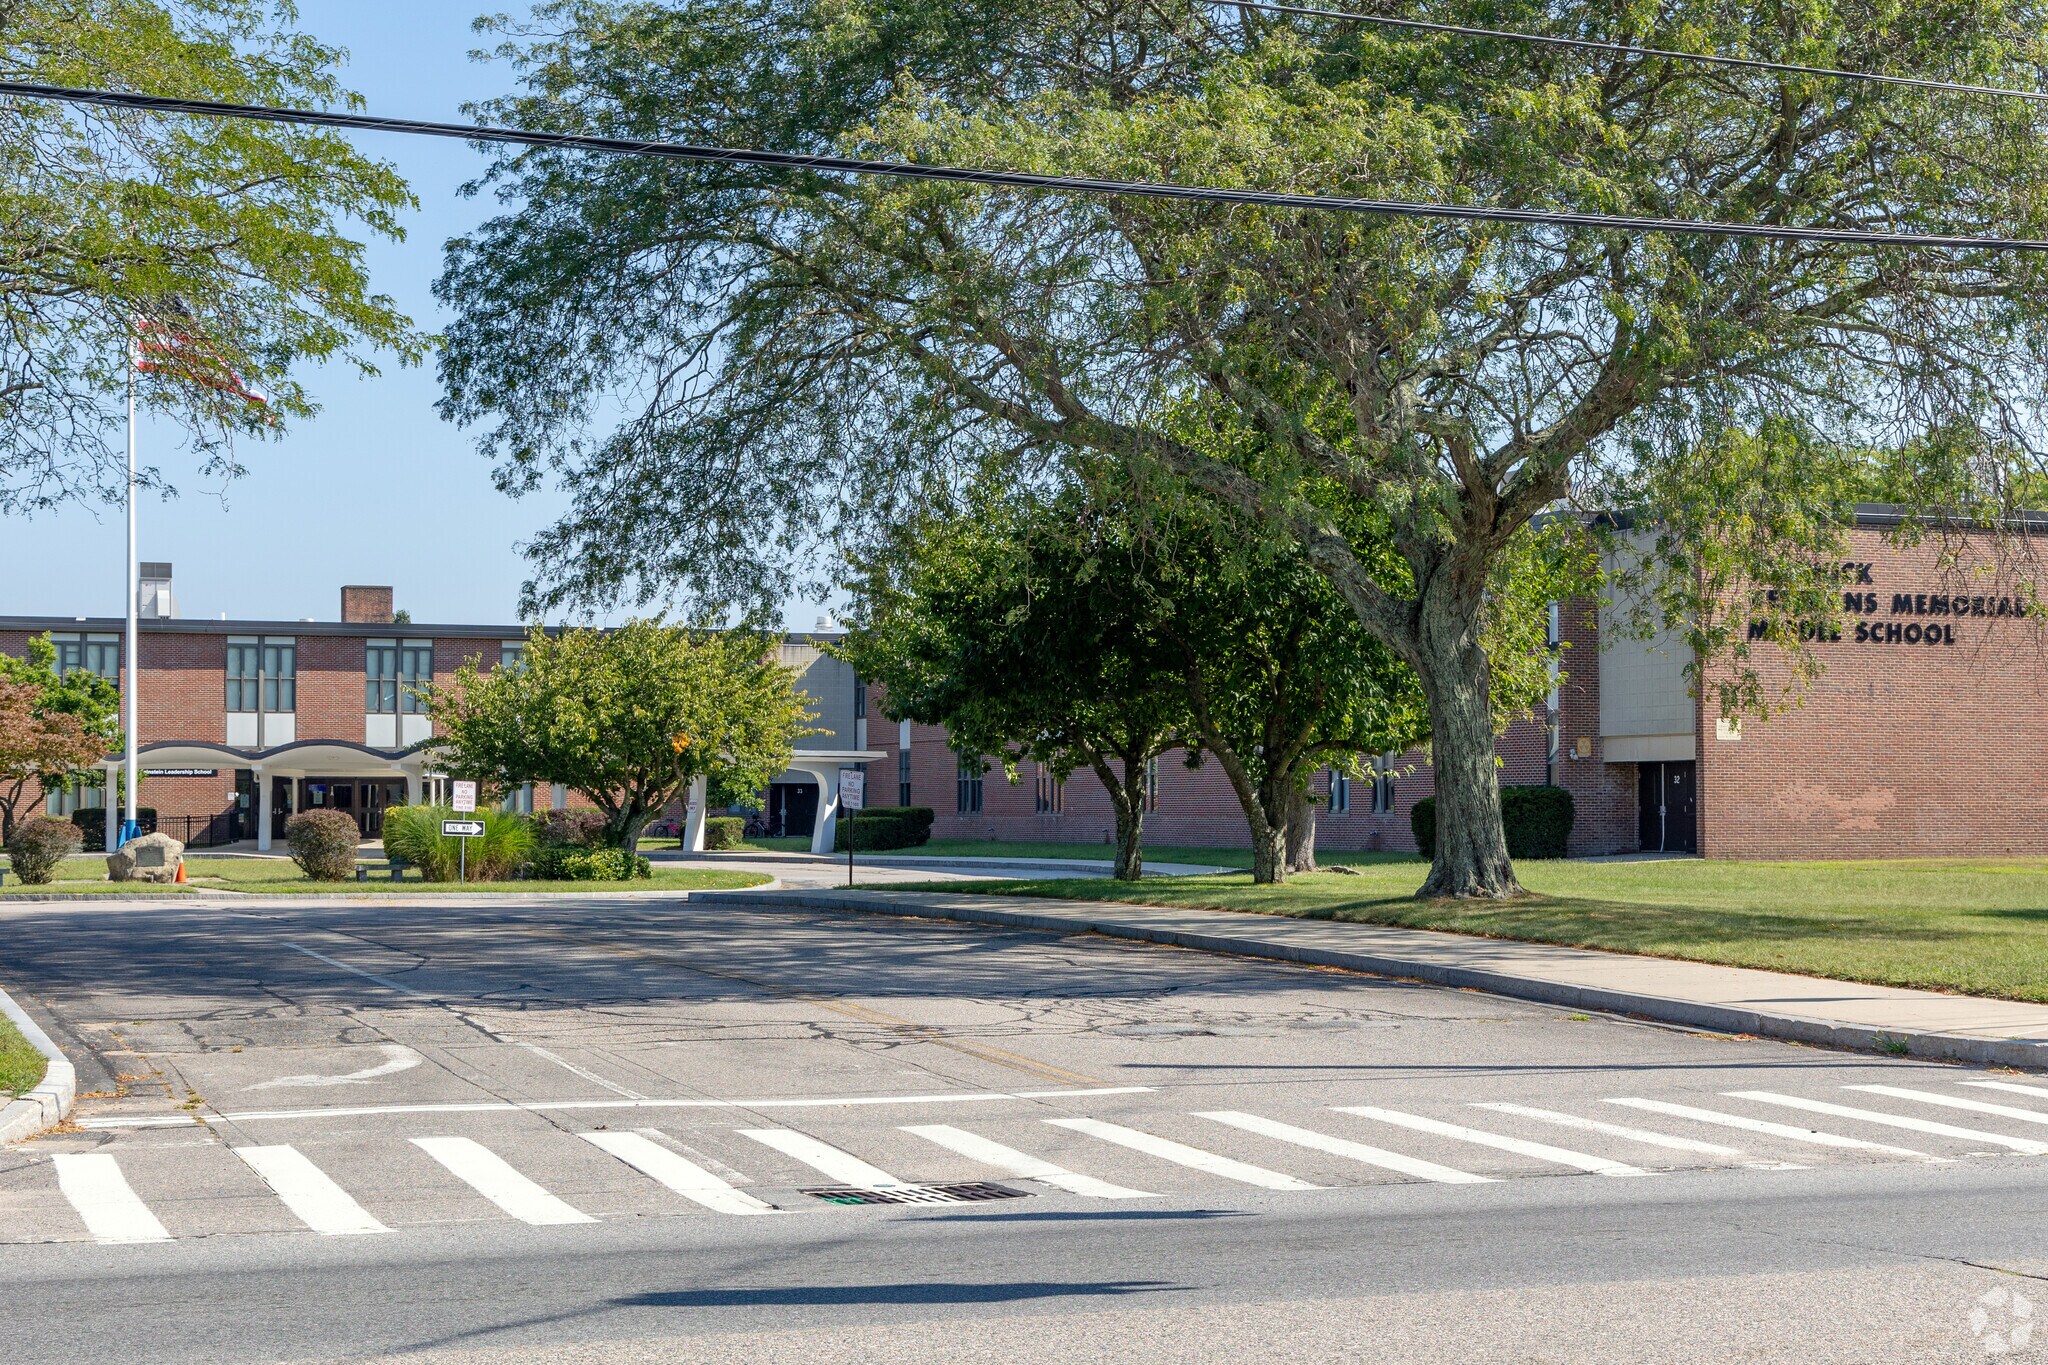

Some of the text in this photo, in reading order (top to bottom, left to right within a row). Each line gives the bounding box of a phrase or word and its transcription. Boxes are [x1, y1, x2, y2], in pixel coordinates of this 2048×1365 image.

[1891, 594, 2031, 617] MEMORIAL
[1855, 621, 1956, 645] SCHOOL
[1673, 775, 1680, 784] 32
[842, 793, 860, 801] ANYTIME
